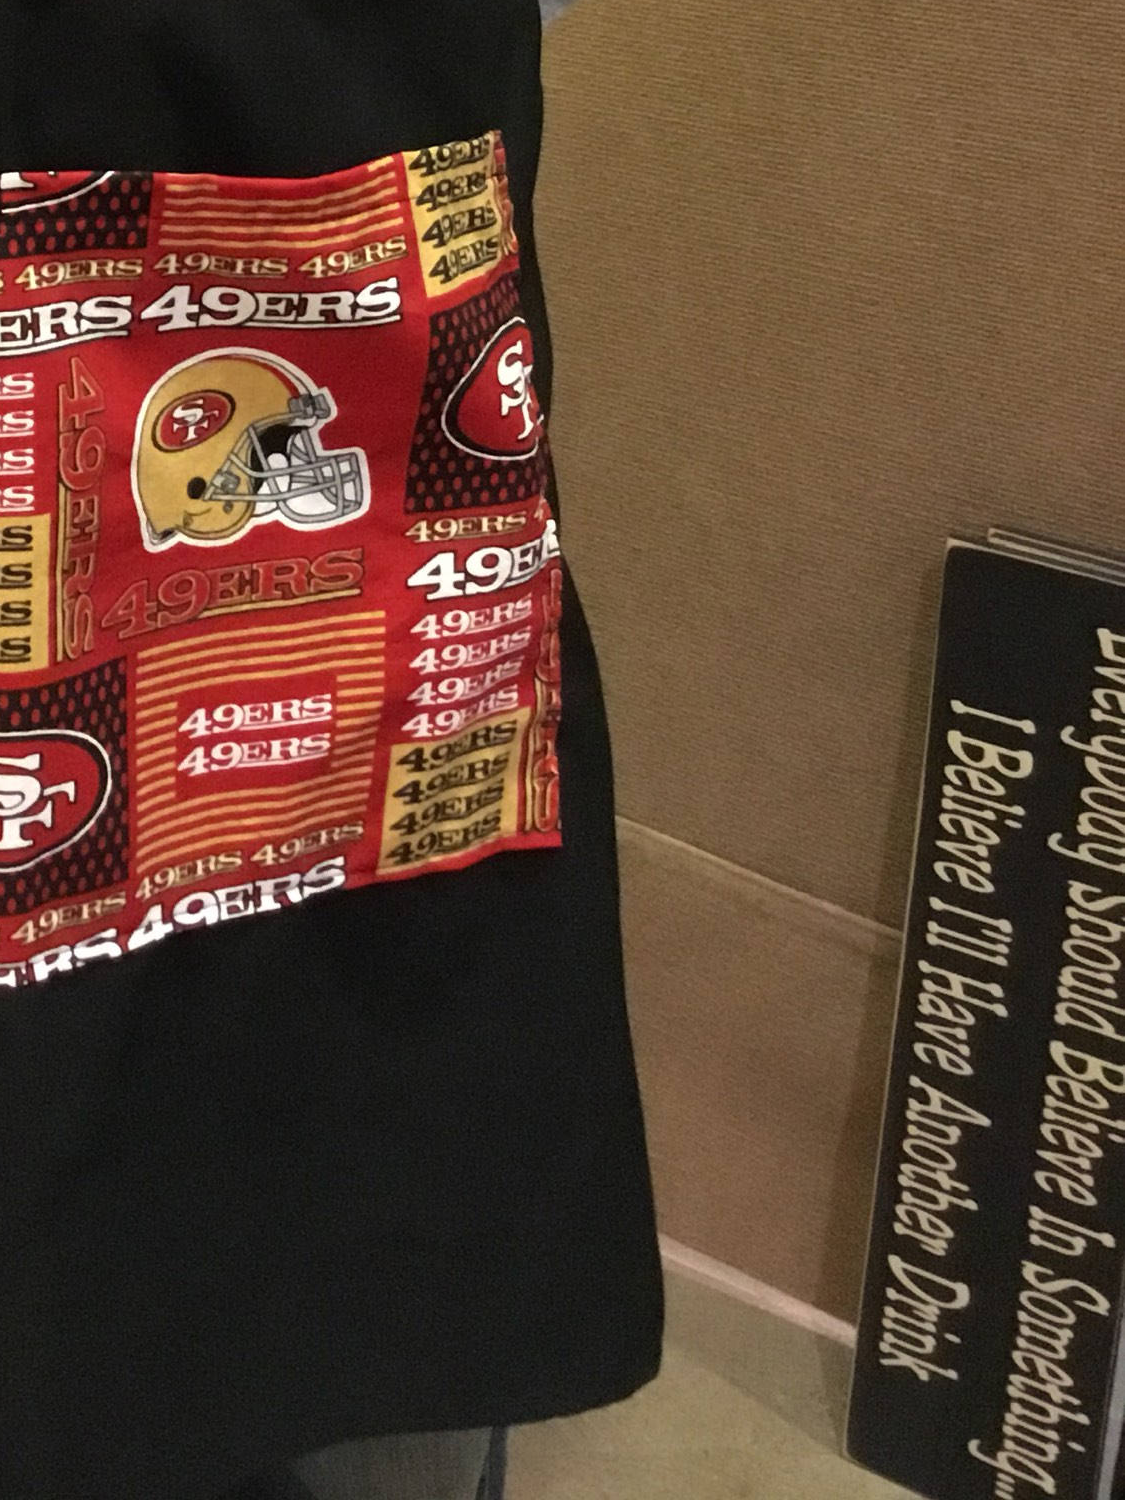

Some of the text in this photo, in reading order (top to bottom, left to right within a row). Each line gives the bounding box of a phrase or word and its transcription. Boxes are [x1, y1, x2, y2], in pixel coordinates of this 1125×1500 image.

[15, 258, 144, 291] 49ERS
[153, 252, 288, 279] 49ERS
[298, 235, 408, 279] 49ERS
[428, 236, 500, 284] 49ERS
[140, 277, 402, 332] 49ERS
[56, 356, 107, 662] 49ERS
[405, 511, 527, 543] 49ERS
[101, 548, 365, 640] 49ERS
[410, 592, 532, 640] 49ERS
[409, 625, 531, 675] 49ERS
[407, 655, 525, 707] 49ERS
[178, 693, 332, 739] 49ERS
[401, 683, 519, 738] 49ERS
[177, 733, 331, 776] 49ERS
[396, 719, 517, 774] 49ERS
[392, 751, 510, 805] 49ERS
[389, 778, 505, 836] 49ERS
[386, 809, 502, 865] 49ERS
[11, 889, 127, 943] 49ERS
[135, 850, 243, 900] 49ERS
[249, 821, 365, 867] 49ERS
[127, 856, 348, 952] 49ERS
[879, 700, 1037, 1381] I Believe I'll Have Another Drink
[1033, 1040, 1125, 1206] Believe
[1028, 1205, 1116, 1256] In
